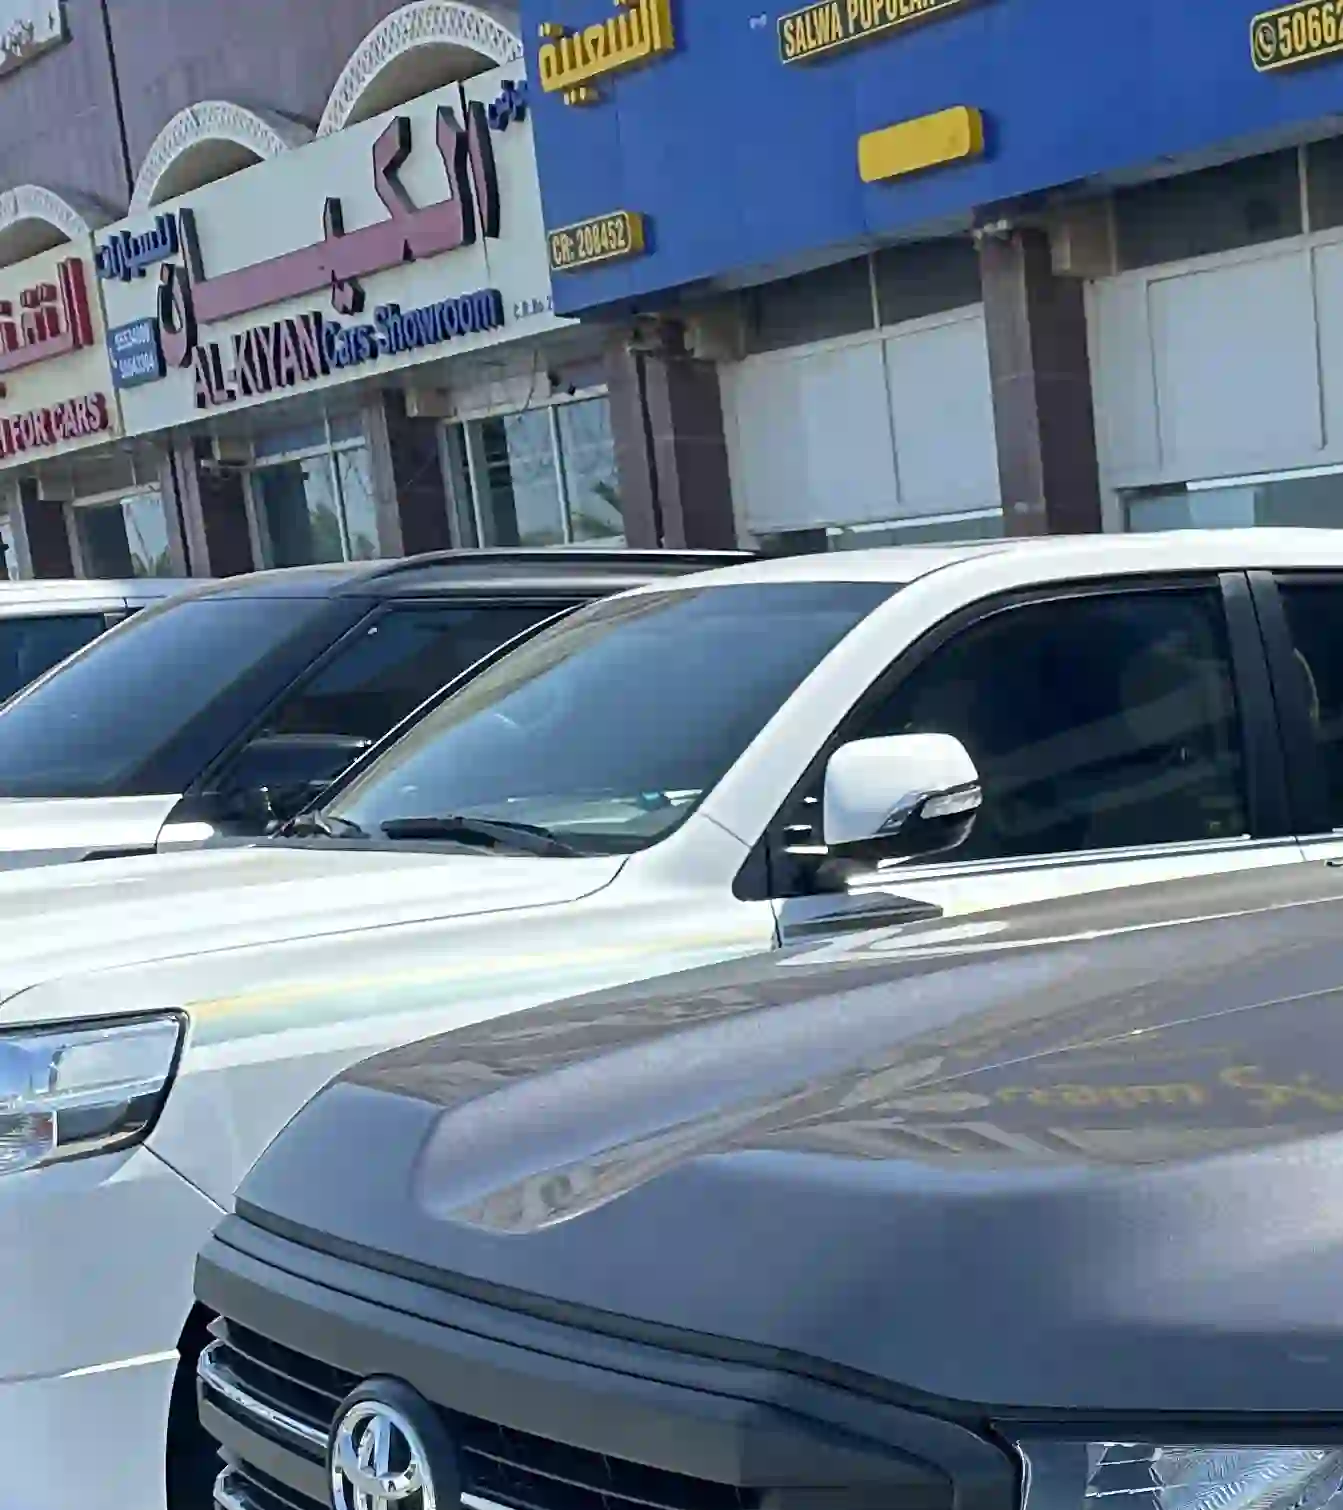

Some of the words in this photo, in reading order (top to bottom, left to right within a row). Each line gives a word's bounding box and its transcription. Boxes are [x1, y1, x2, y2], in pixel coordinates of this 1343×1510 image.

[784, 2, 843, 57] SALWA
[552, 233, 575, 265] CR:
[193, 310, 330, 409] AL-KIYAN
[322, 321, 379, 369] Cars
[374, 288, 505, 356] Showroom
[9, 409, 57, 451] FOR
[50, 392, 108, 440] CARS
